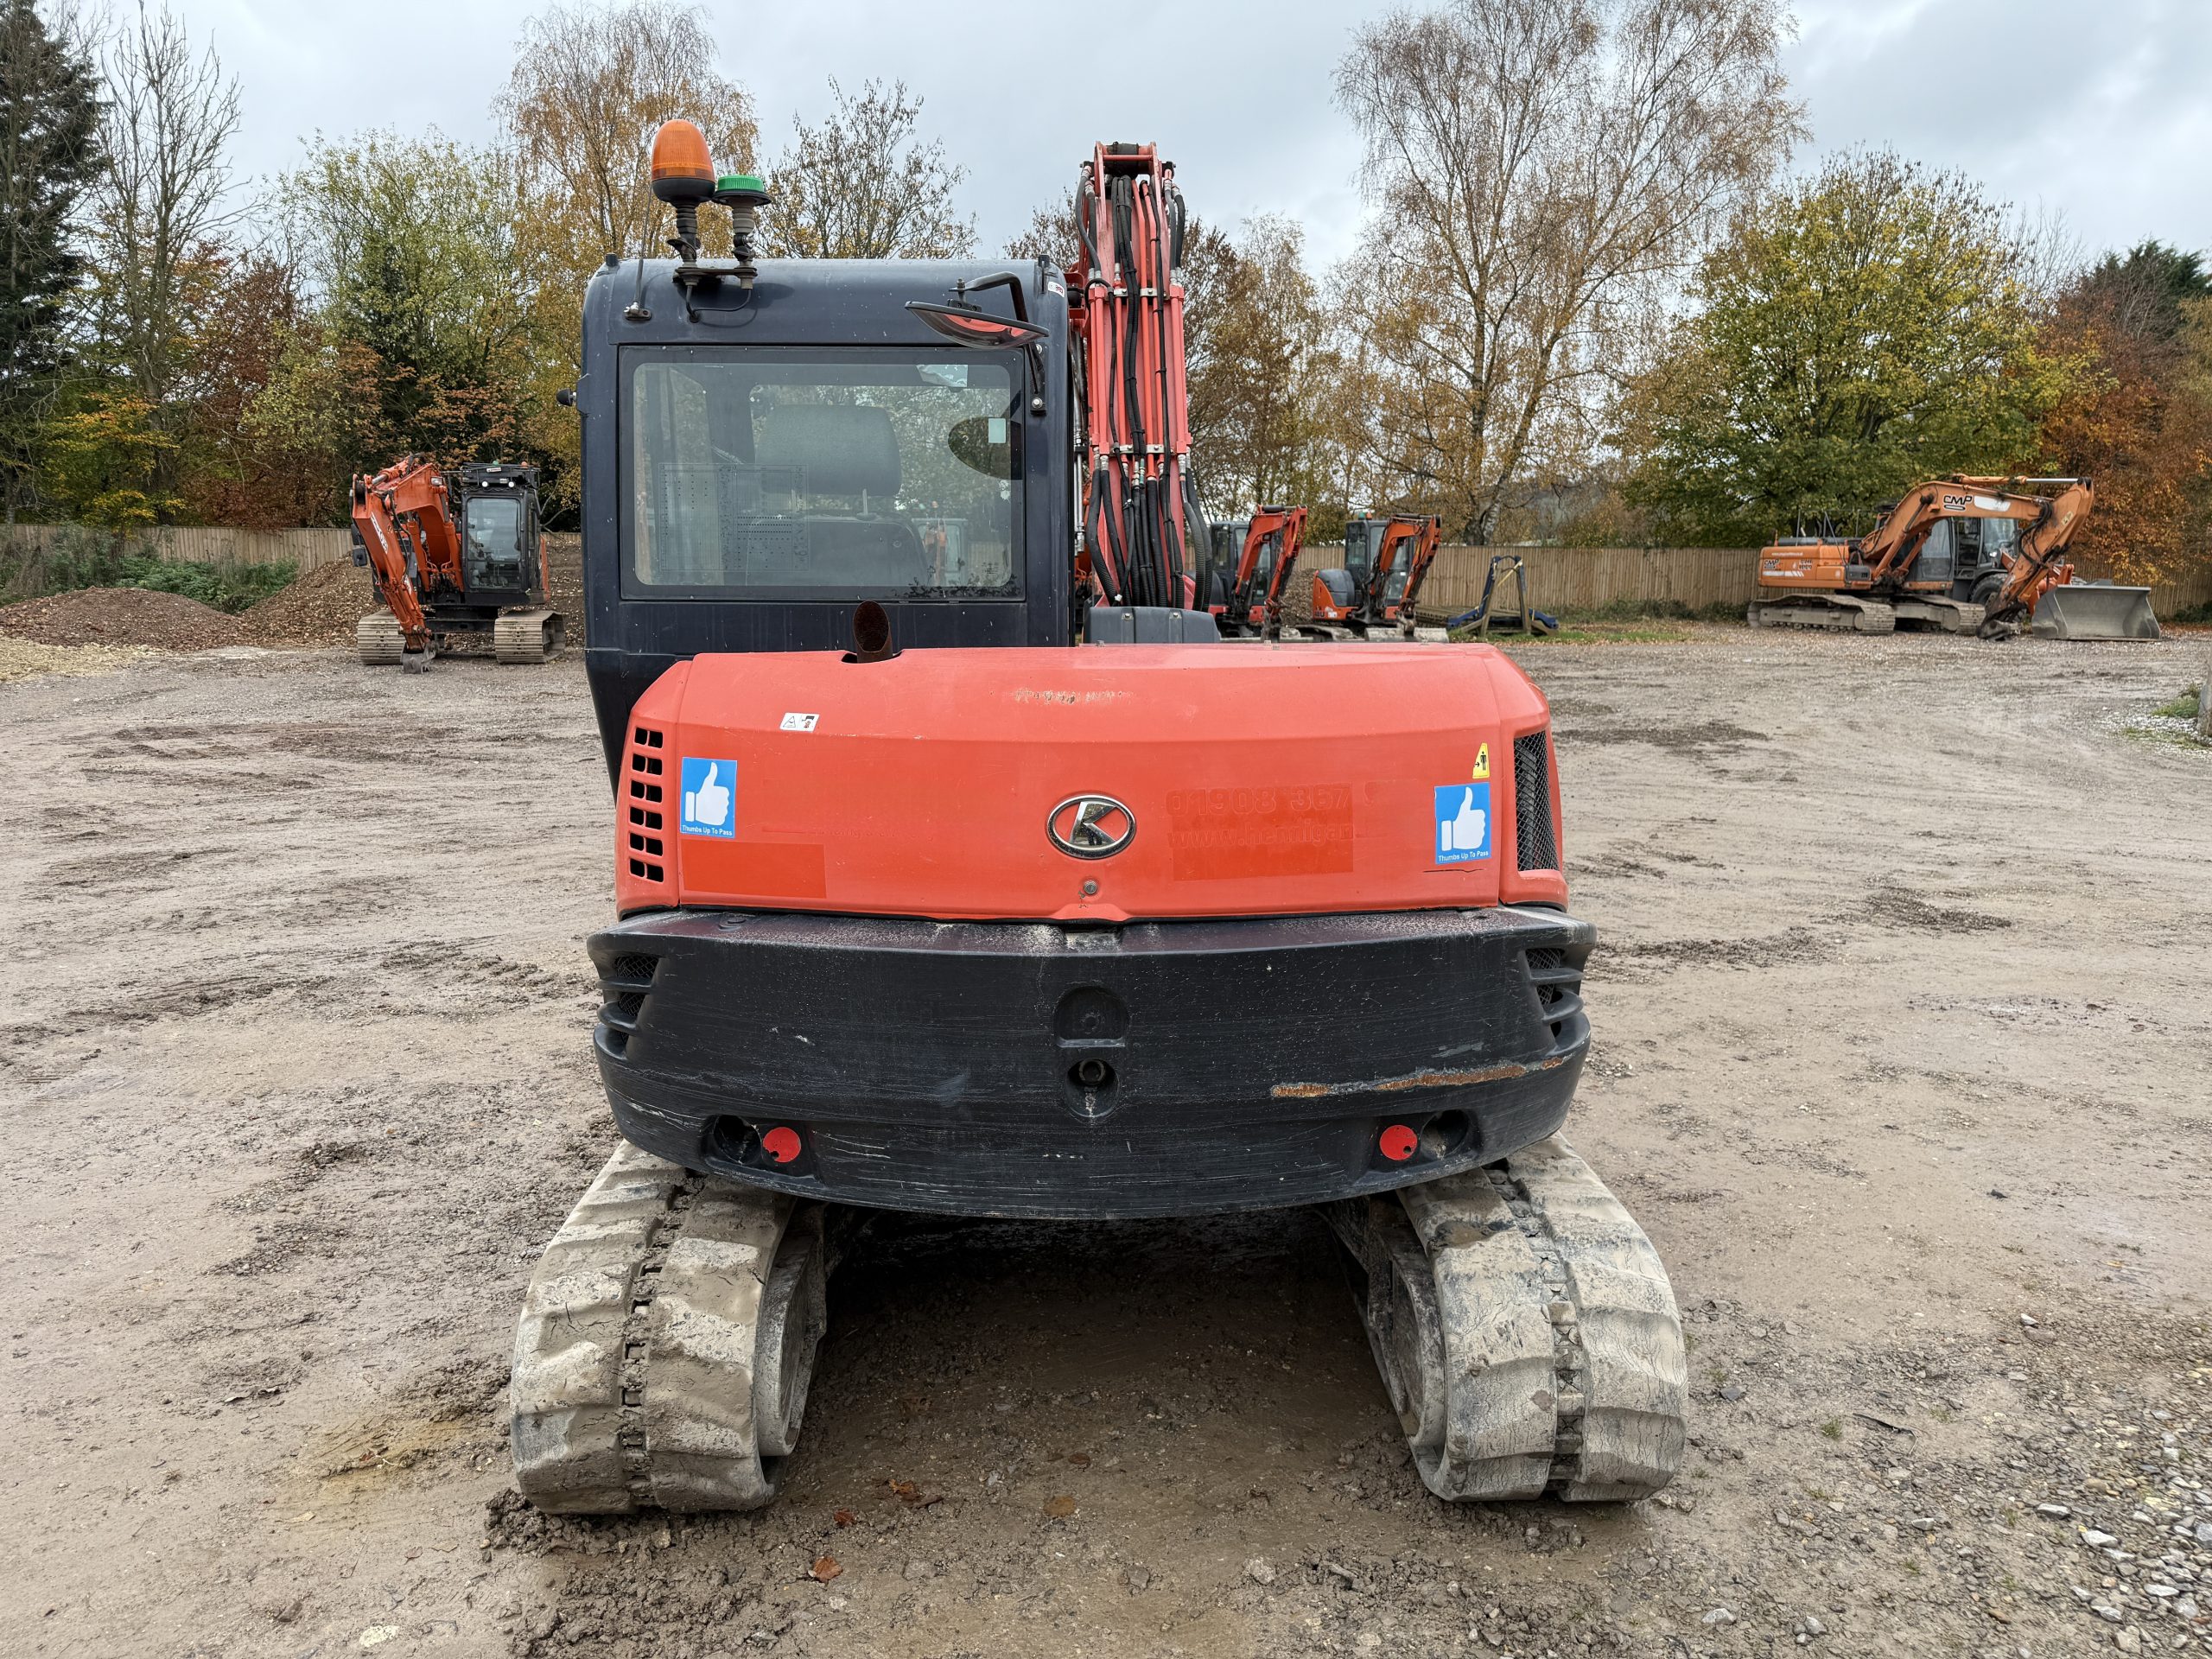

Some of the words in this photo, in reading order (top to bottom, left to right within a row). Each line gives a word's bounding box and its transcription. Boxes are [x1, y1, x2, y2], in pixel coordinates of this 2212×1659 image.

[1943, 495, 1973, 505] CMP
[1166, 787, 1276, 817] 01908
[682, 824, 702, 833] Thumbs
[703, 826, 710, 836] Up
